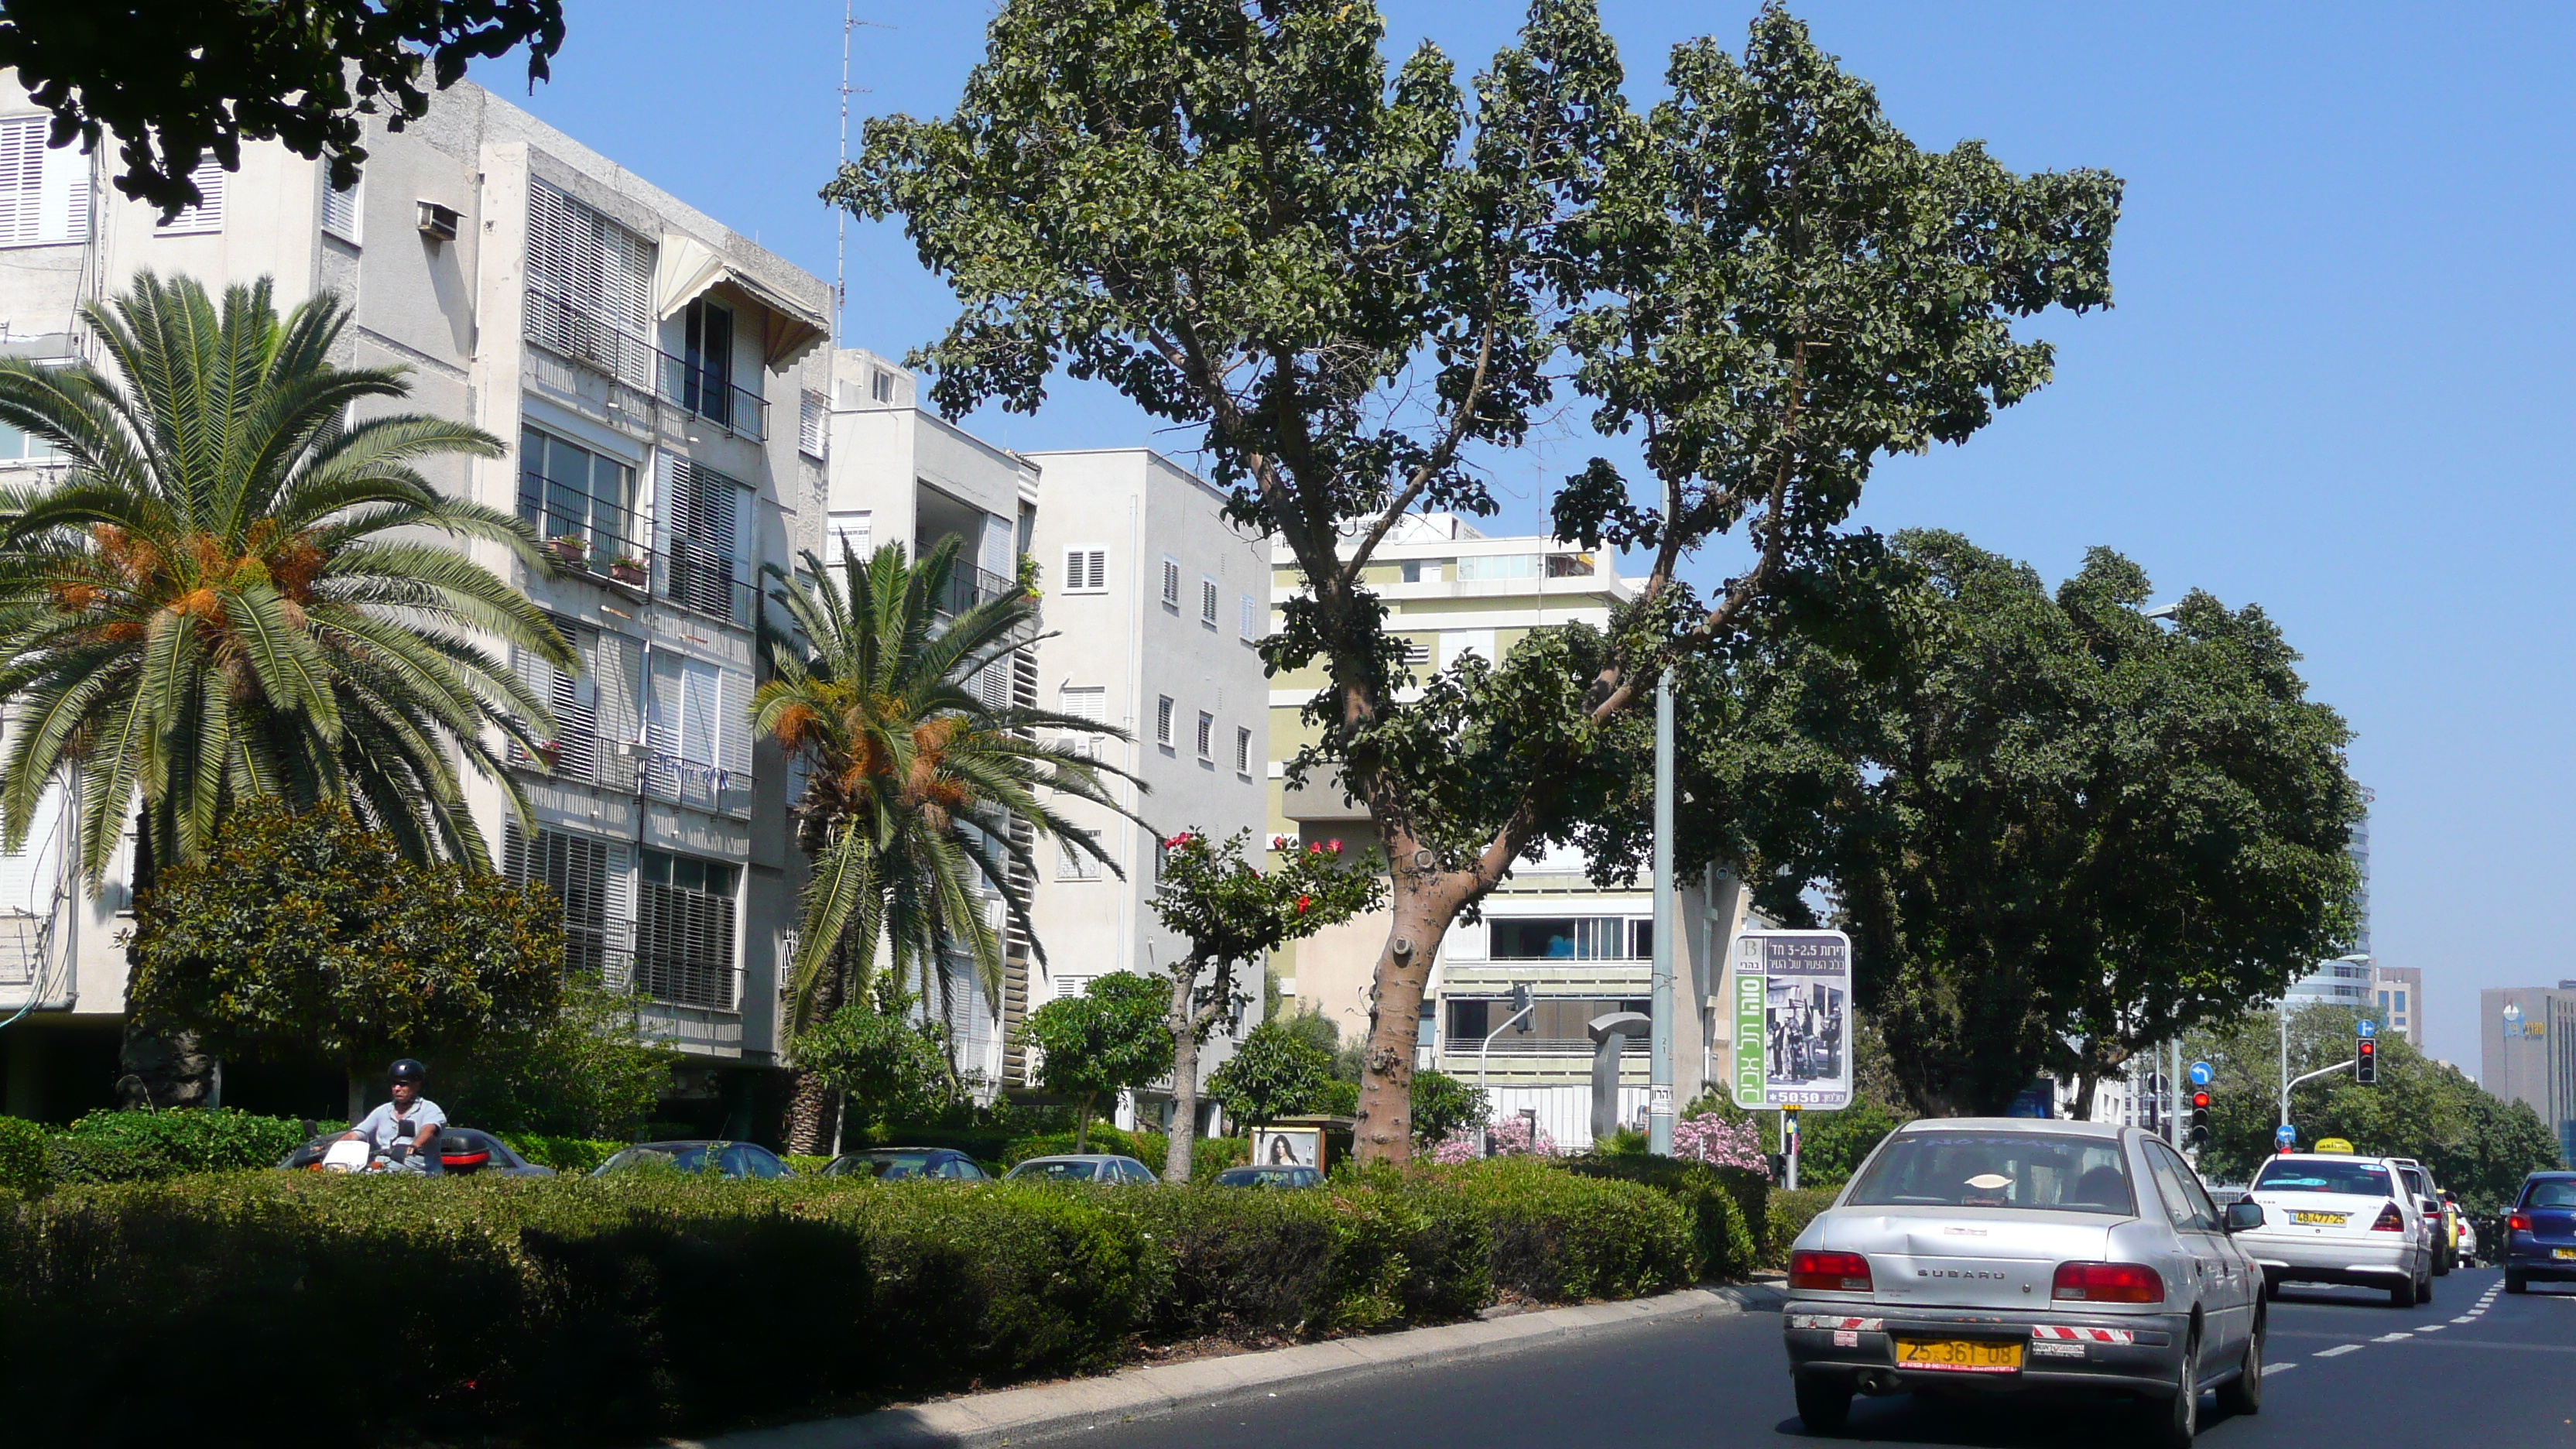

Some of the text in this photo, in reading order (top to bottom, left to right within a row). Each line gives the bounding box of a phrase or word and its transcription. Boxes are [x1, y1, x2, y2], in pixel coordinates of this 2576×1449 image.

[1744, 940, 1757, 957] B
[1820, 945, 1845, 957] דירות
[1740, 961, 1759, 969] בהרי
[1769, 957, 1845, 970] בלב הצעיר של העיר
[1741, 978, 1760, 1016] סוהו
[1736, 1023, 1760, 1050] תל
[1741, 1057, 1760, 1101] אביב
[1917, 1267, 2006, 1280] SUBARU
